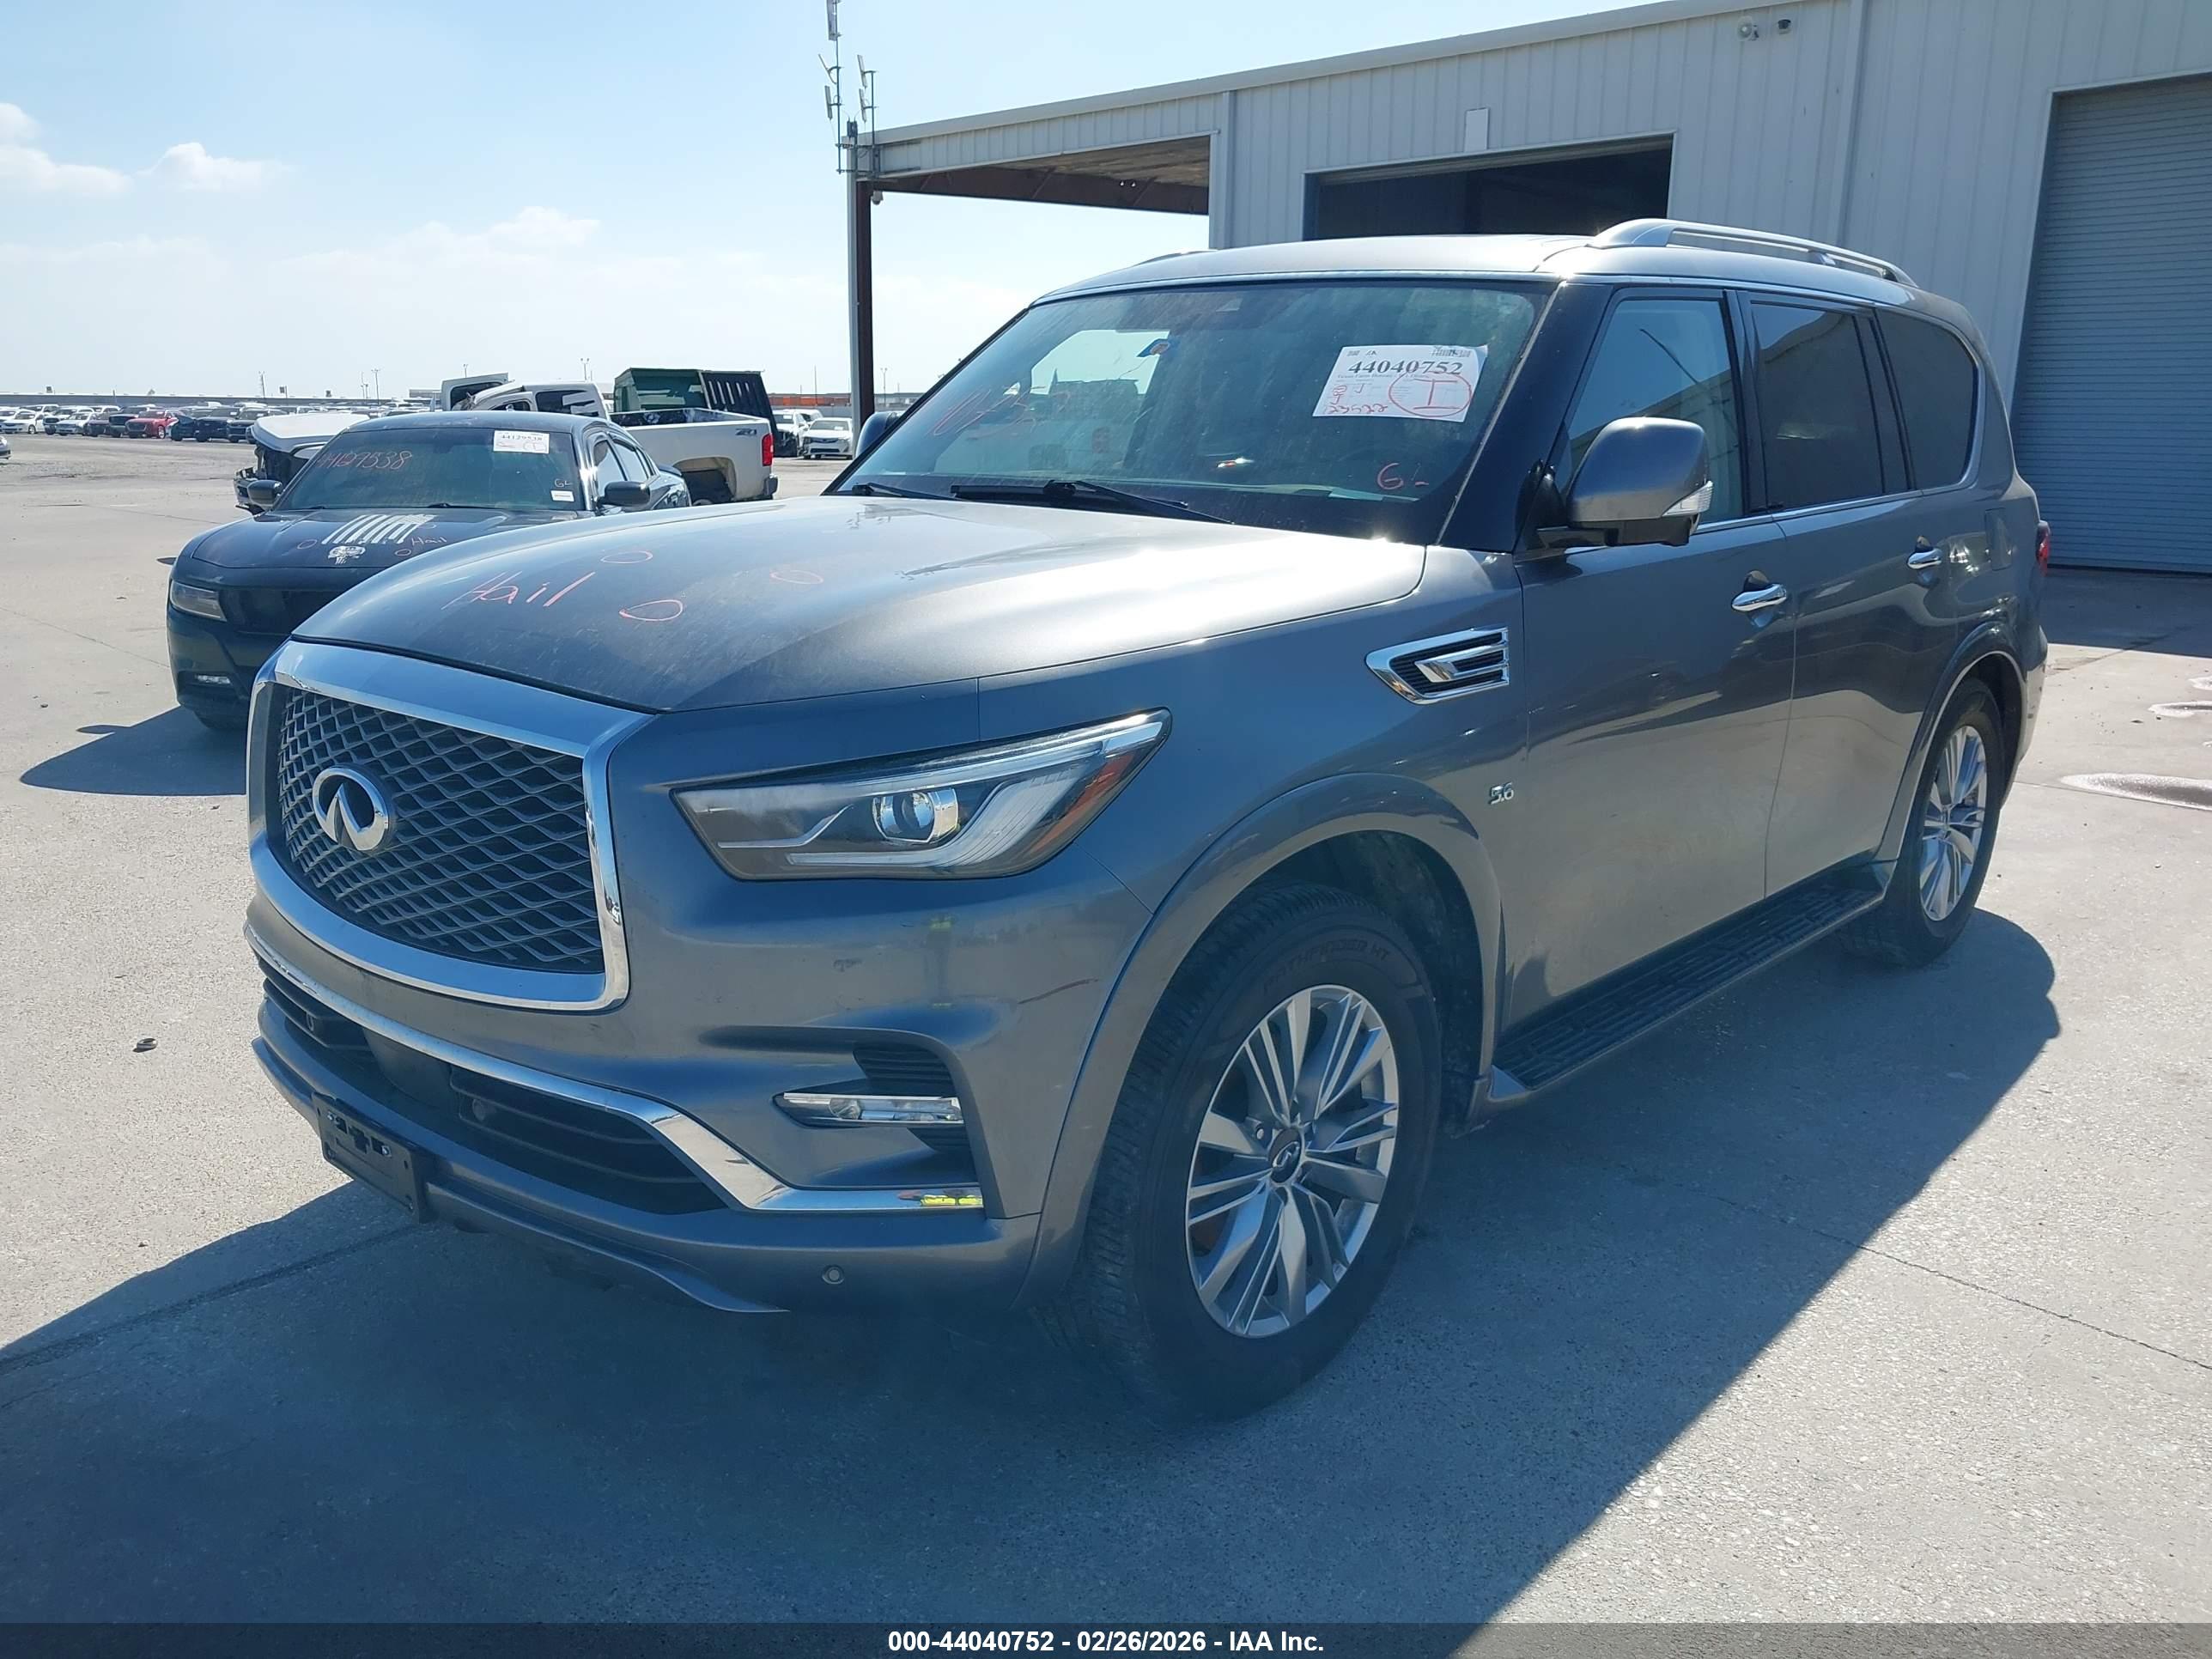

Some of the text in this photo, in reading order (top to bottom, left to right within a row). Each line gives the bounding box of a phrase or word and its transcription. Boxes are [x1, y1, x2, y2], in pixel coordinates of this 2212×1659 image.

[1348, 360, 1463, 376] 44040752
[441, 570, 596, 607] Hail
[1490, 781, 1515, 805] 5.6
